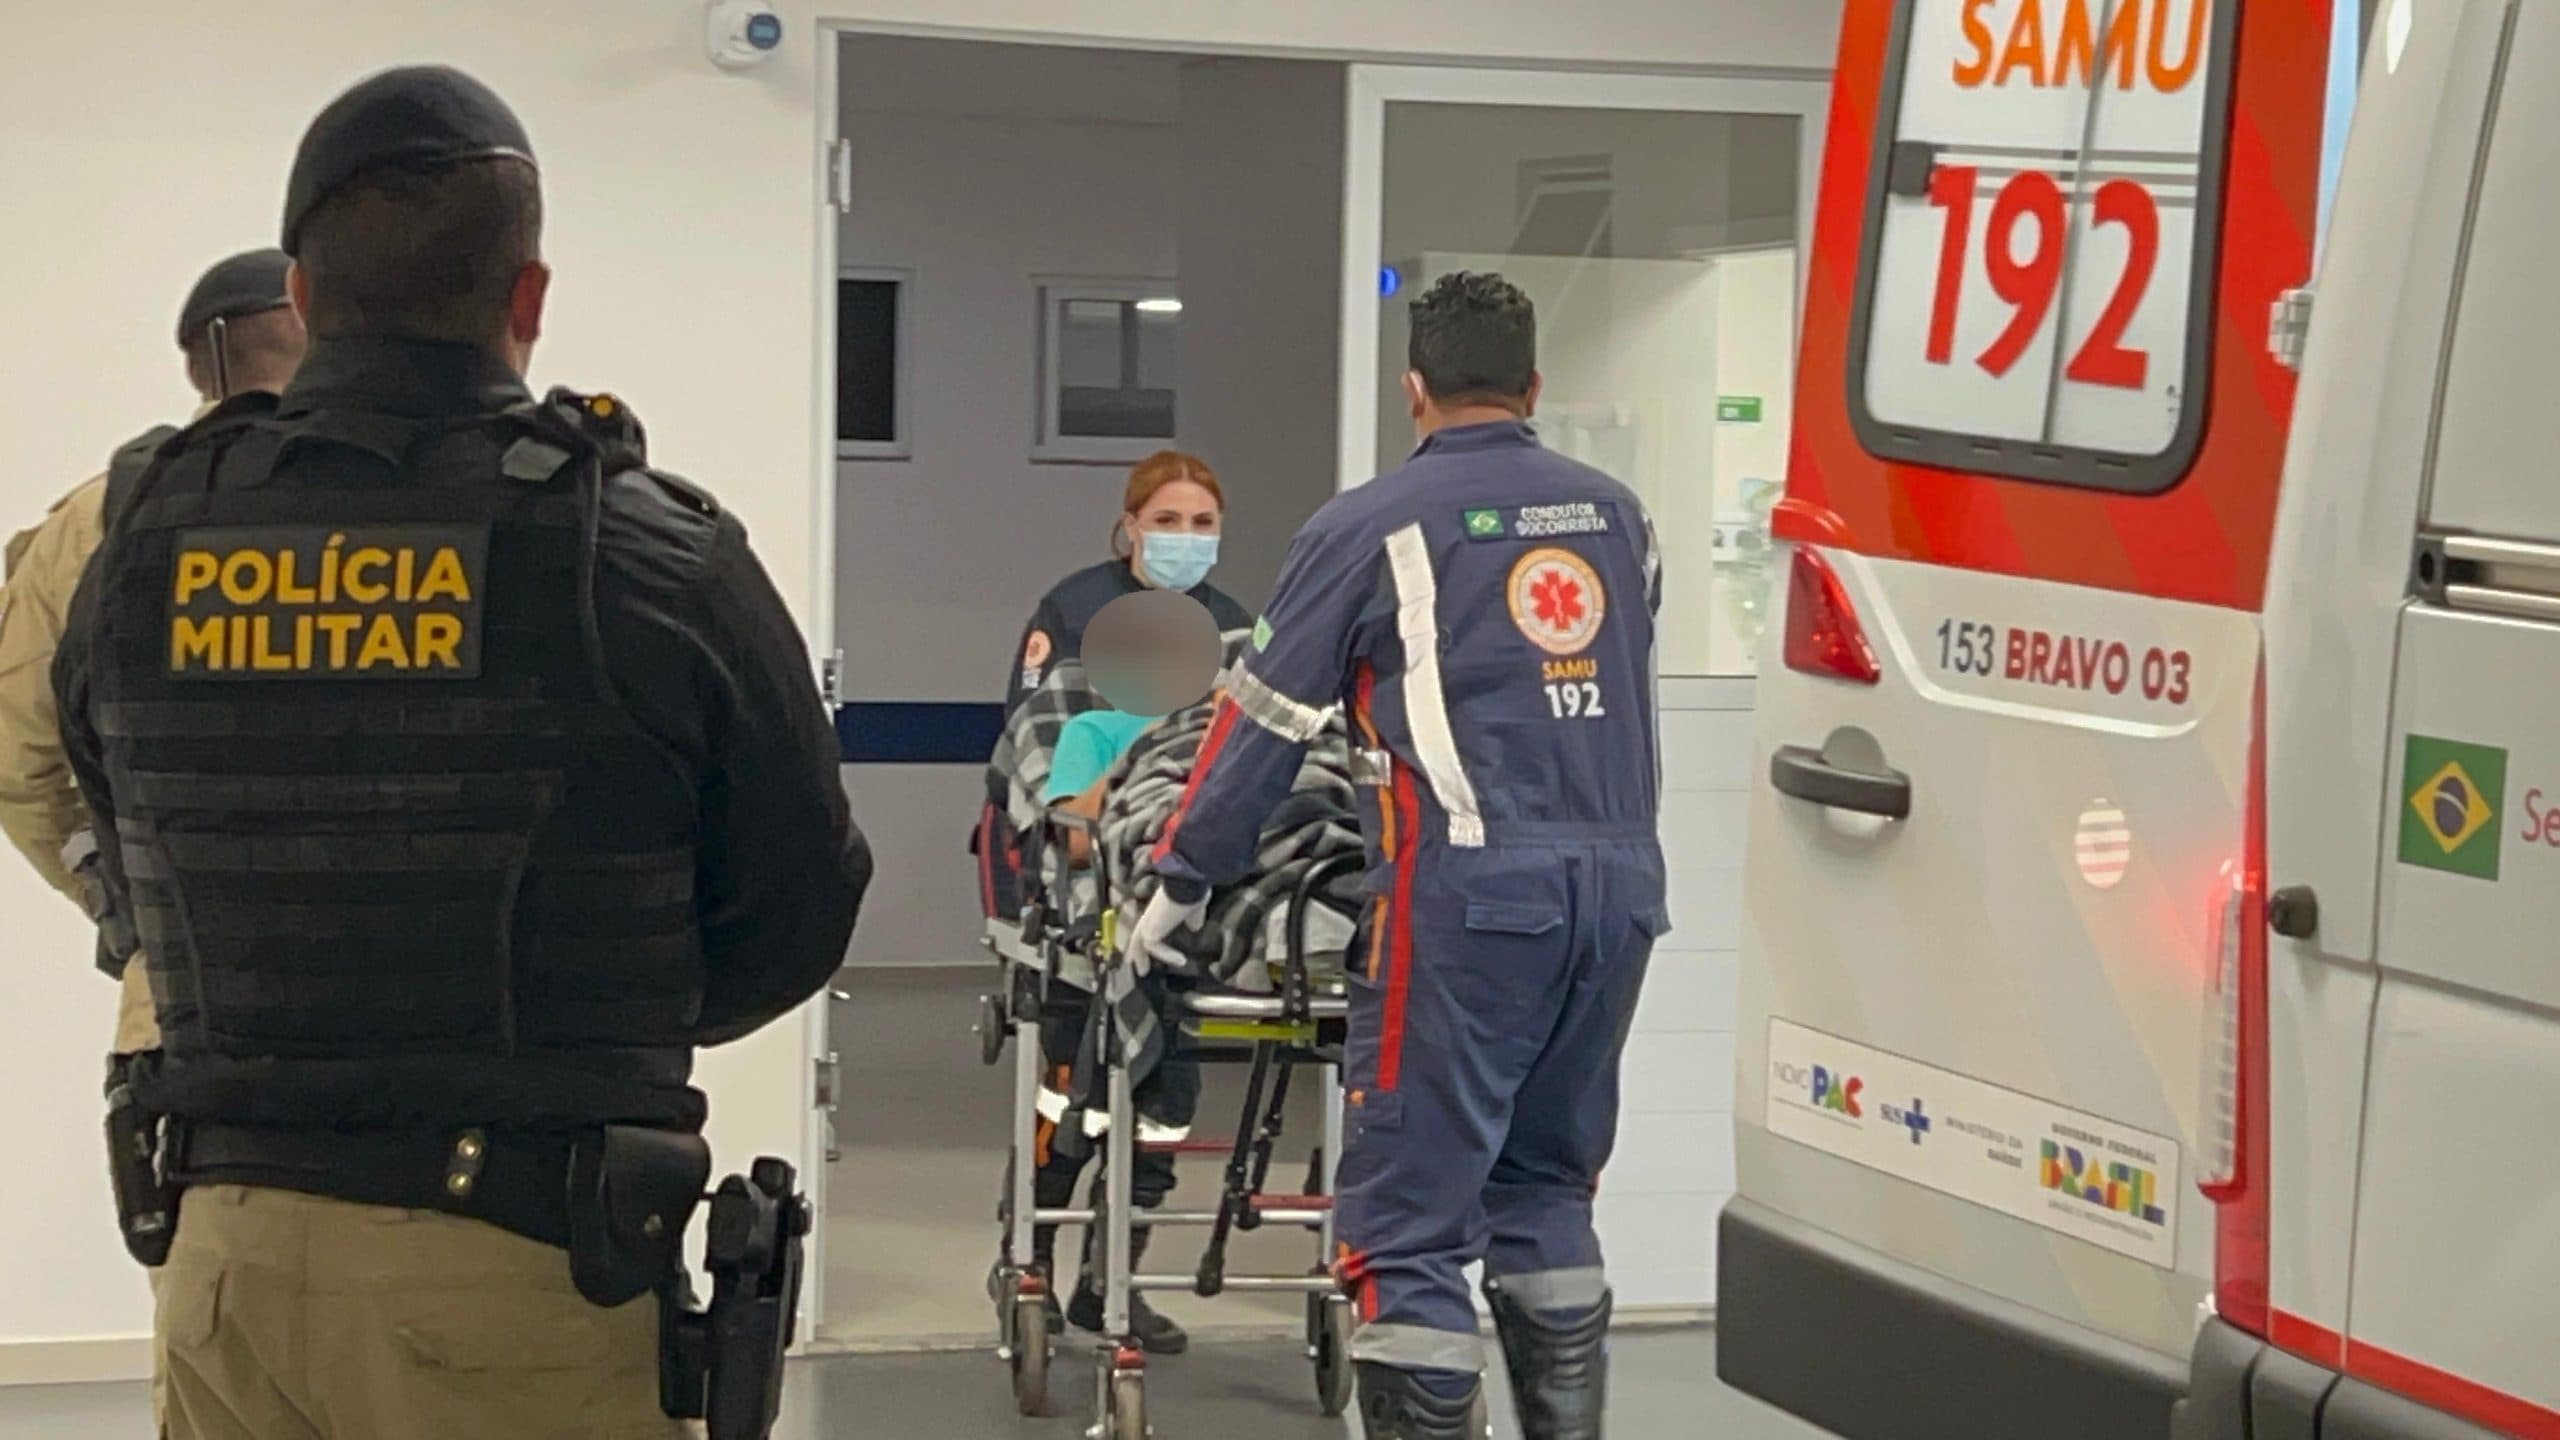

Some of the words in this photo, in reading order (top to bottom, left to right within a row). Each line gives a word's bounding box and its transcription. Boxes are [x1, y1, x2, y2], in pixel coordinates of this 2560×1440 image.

[1953, 0, 2210, 92] SAMU
[1926, 165, 2160, 390] 192
[1514, 517, 1608, 536] SOCORRISTA
[1520, 503, 1596, 521] CONDUTOR
[175, 533, 472, 605] POLÍCIA
[171, 613, 465, 671] MILITAR
[1542, 658, 1597, 681] SAMU
[1937, 618, 1995, 677] 153
[2004, 627, 2130, 695] BRAVO
[2141, 647, 2191, 705] 03
[1544, 682, 1605, 719] 192
[1812, 1064, 1864, 1119] PAC
[2040, 1137, 2165, 1227] BRASIL
